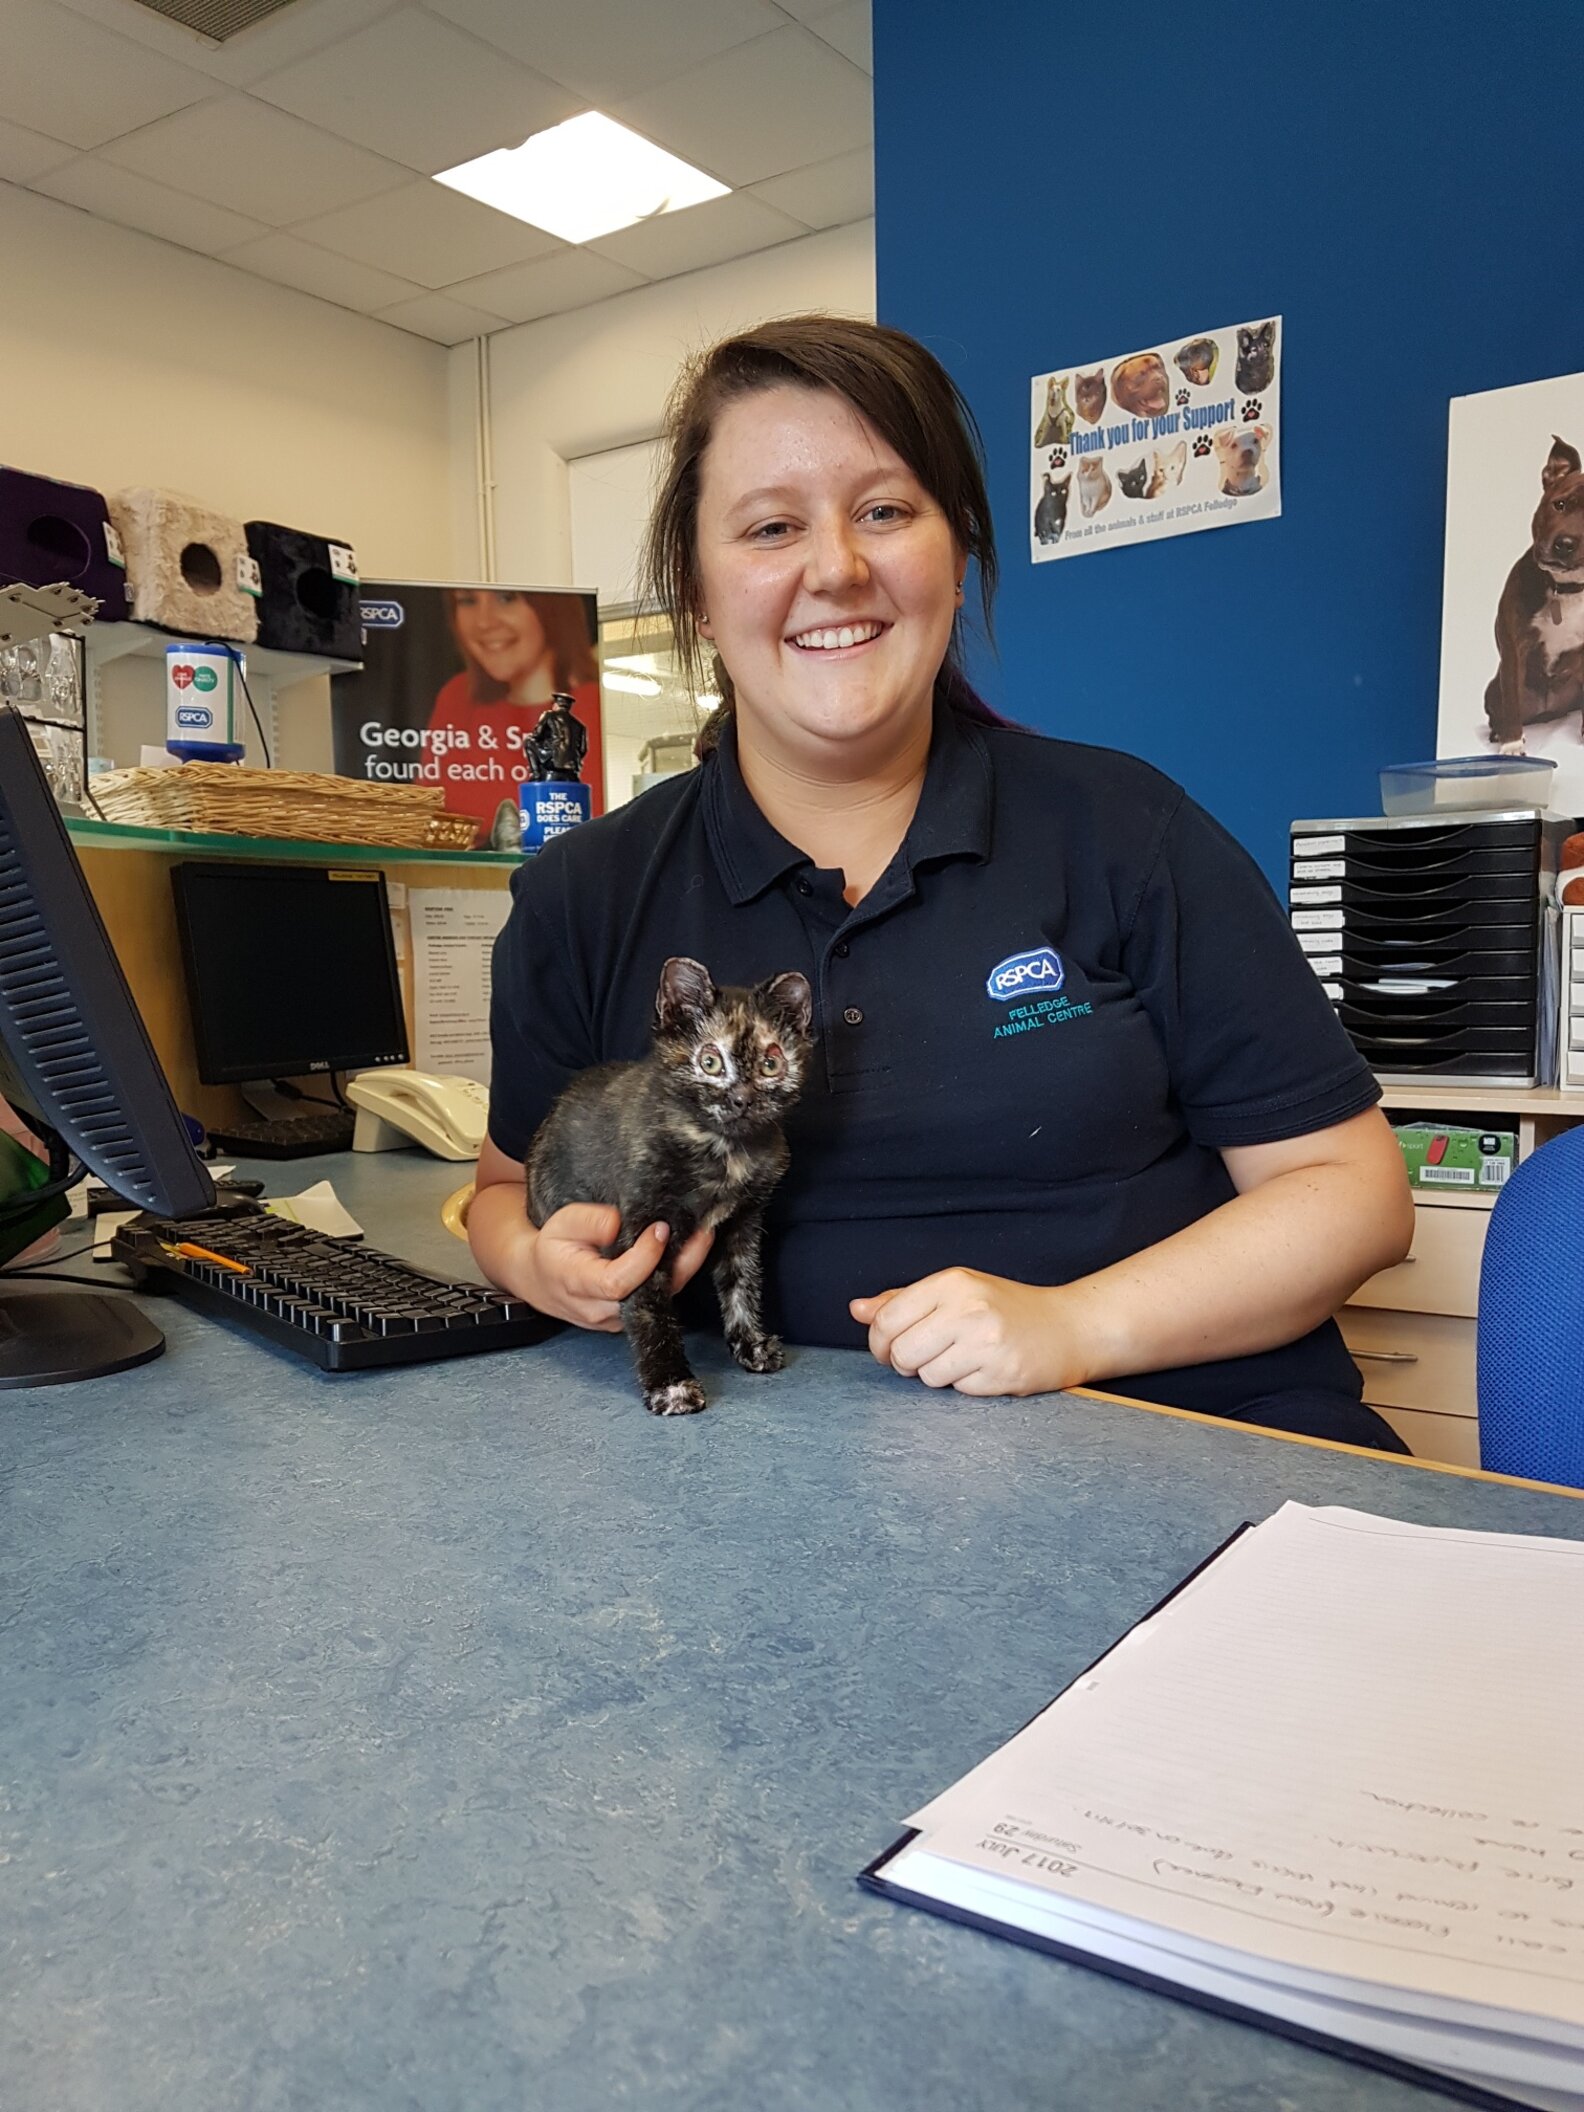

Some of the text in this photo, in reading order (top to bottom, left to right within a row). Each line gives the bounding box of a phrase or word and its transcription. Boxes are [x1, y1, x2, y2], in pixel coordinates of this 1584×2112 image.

[1070, 398, 1236, 456] Thank you for your Support
[1065, 529, 1083, 541] From
[1084, 525, 1093, 535] all
[1095, 523, 1107, 534] the
[1108, 516, 1137, 531] animals
[1138, 515, 1145, 526] &
[1166, 507, 1175, 519] at
[1176, 503, 1202, 518] RSPCA
[360, 607, 398, 620] SPCA
[179, 712, 208, 723] RSPCA
[360, 722, 470, 755] Georgia
[478, 725, 499, 749] &
[365, 755, 440, 779] found
[447, 757, 504, 780] each
[535, 801, 582, 815] RSPCA
[549, 792, 568, 801] THE
[536, 815, 559, 823] DOES
[561, 815, 582, 823] CARE
[995, 959, 1057, 990] RSPCA
[994, 1002, 1093, 1039] ANIMAL CENTRE
[1009, 996, 1071, 1020] FELLEDGE
[310, 1061, 330, 1070] DELL
[993, 1822, 1082, 1853] Saturday 29
[975, 1839, 1077, 1878] 2017 JULY
